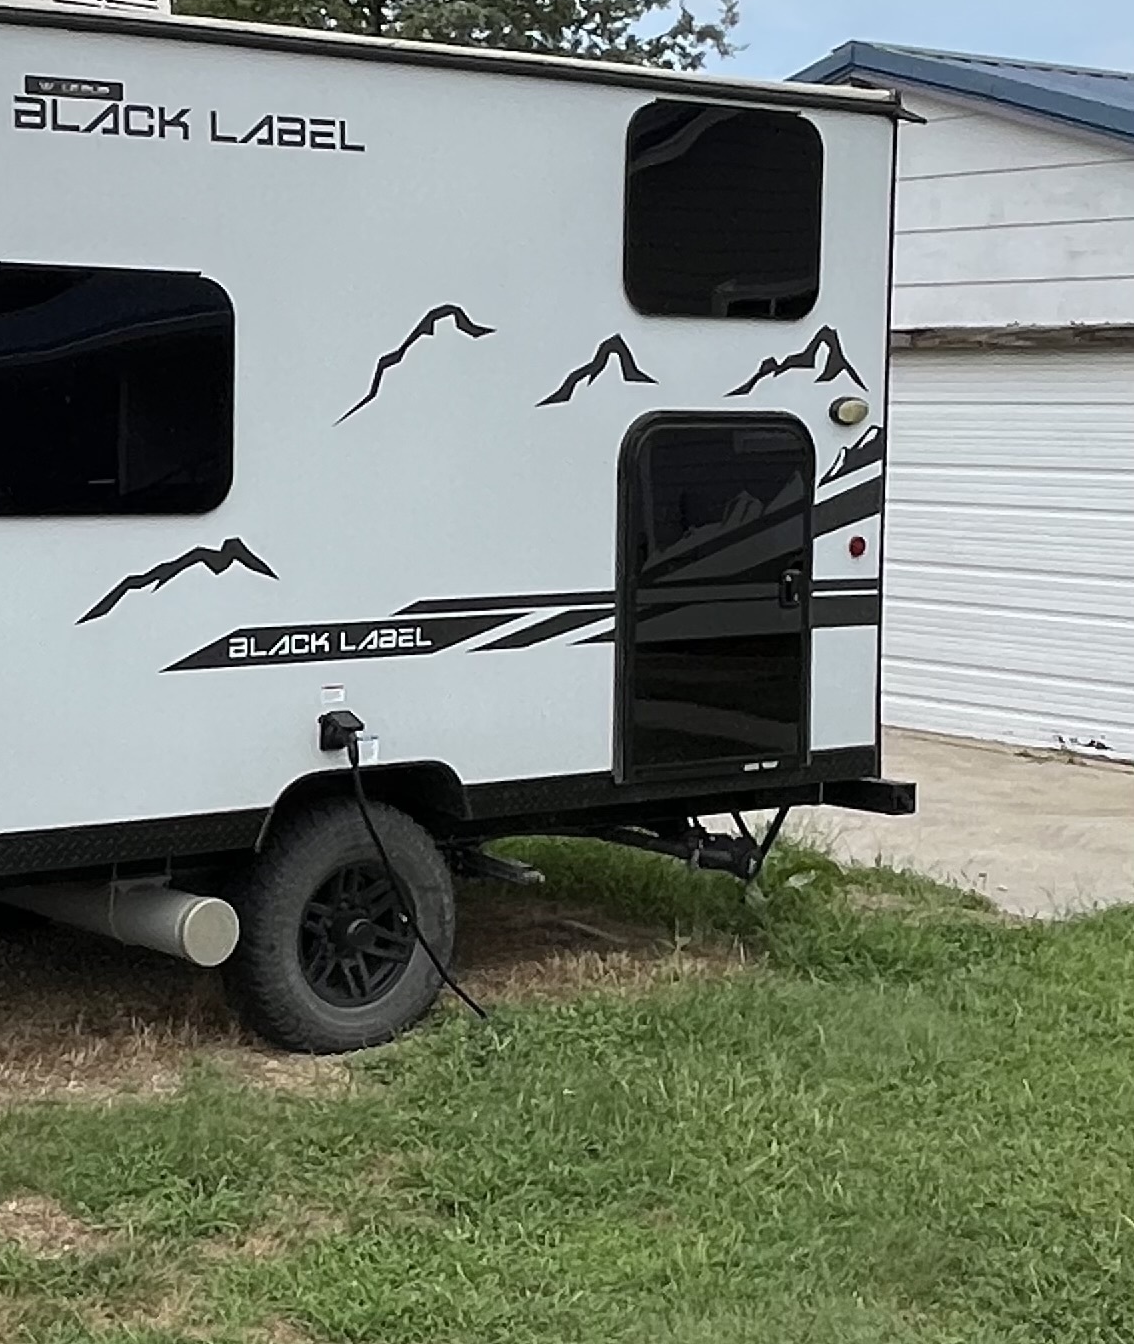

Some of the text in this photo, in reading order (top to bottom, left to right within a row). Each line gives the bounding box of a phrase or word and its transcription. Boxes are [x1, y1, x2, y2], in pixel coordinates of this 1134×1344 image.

[13, 95, 366, 152] BLACK LABEL
[228, 626, 433, 658] BLACK LABEL
